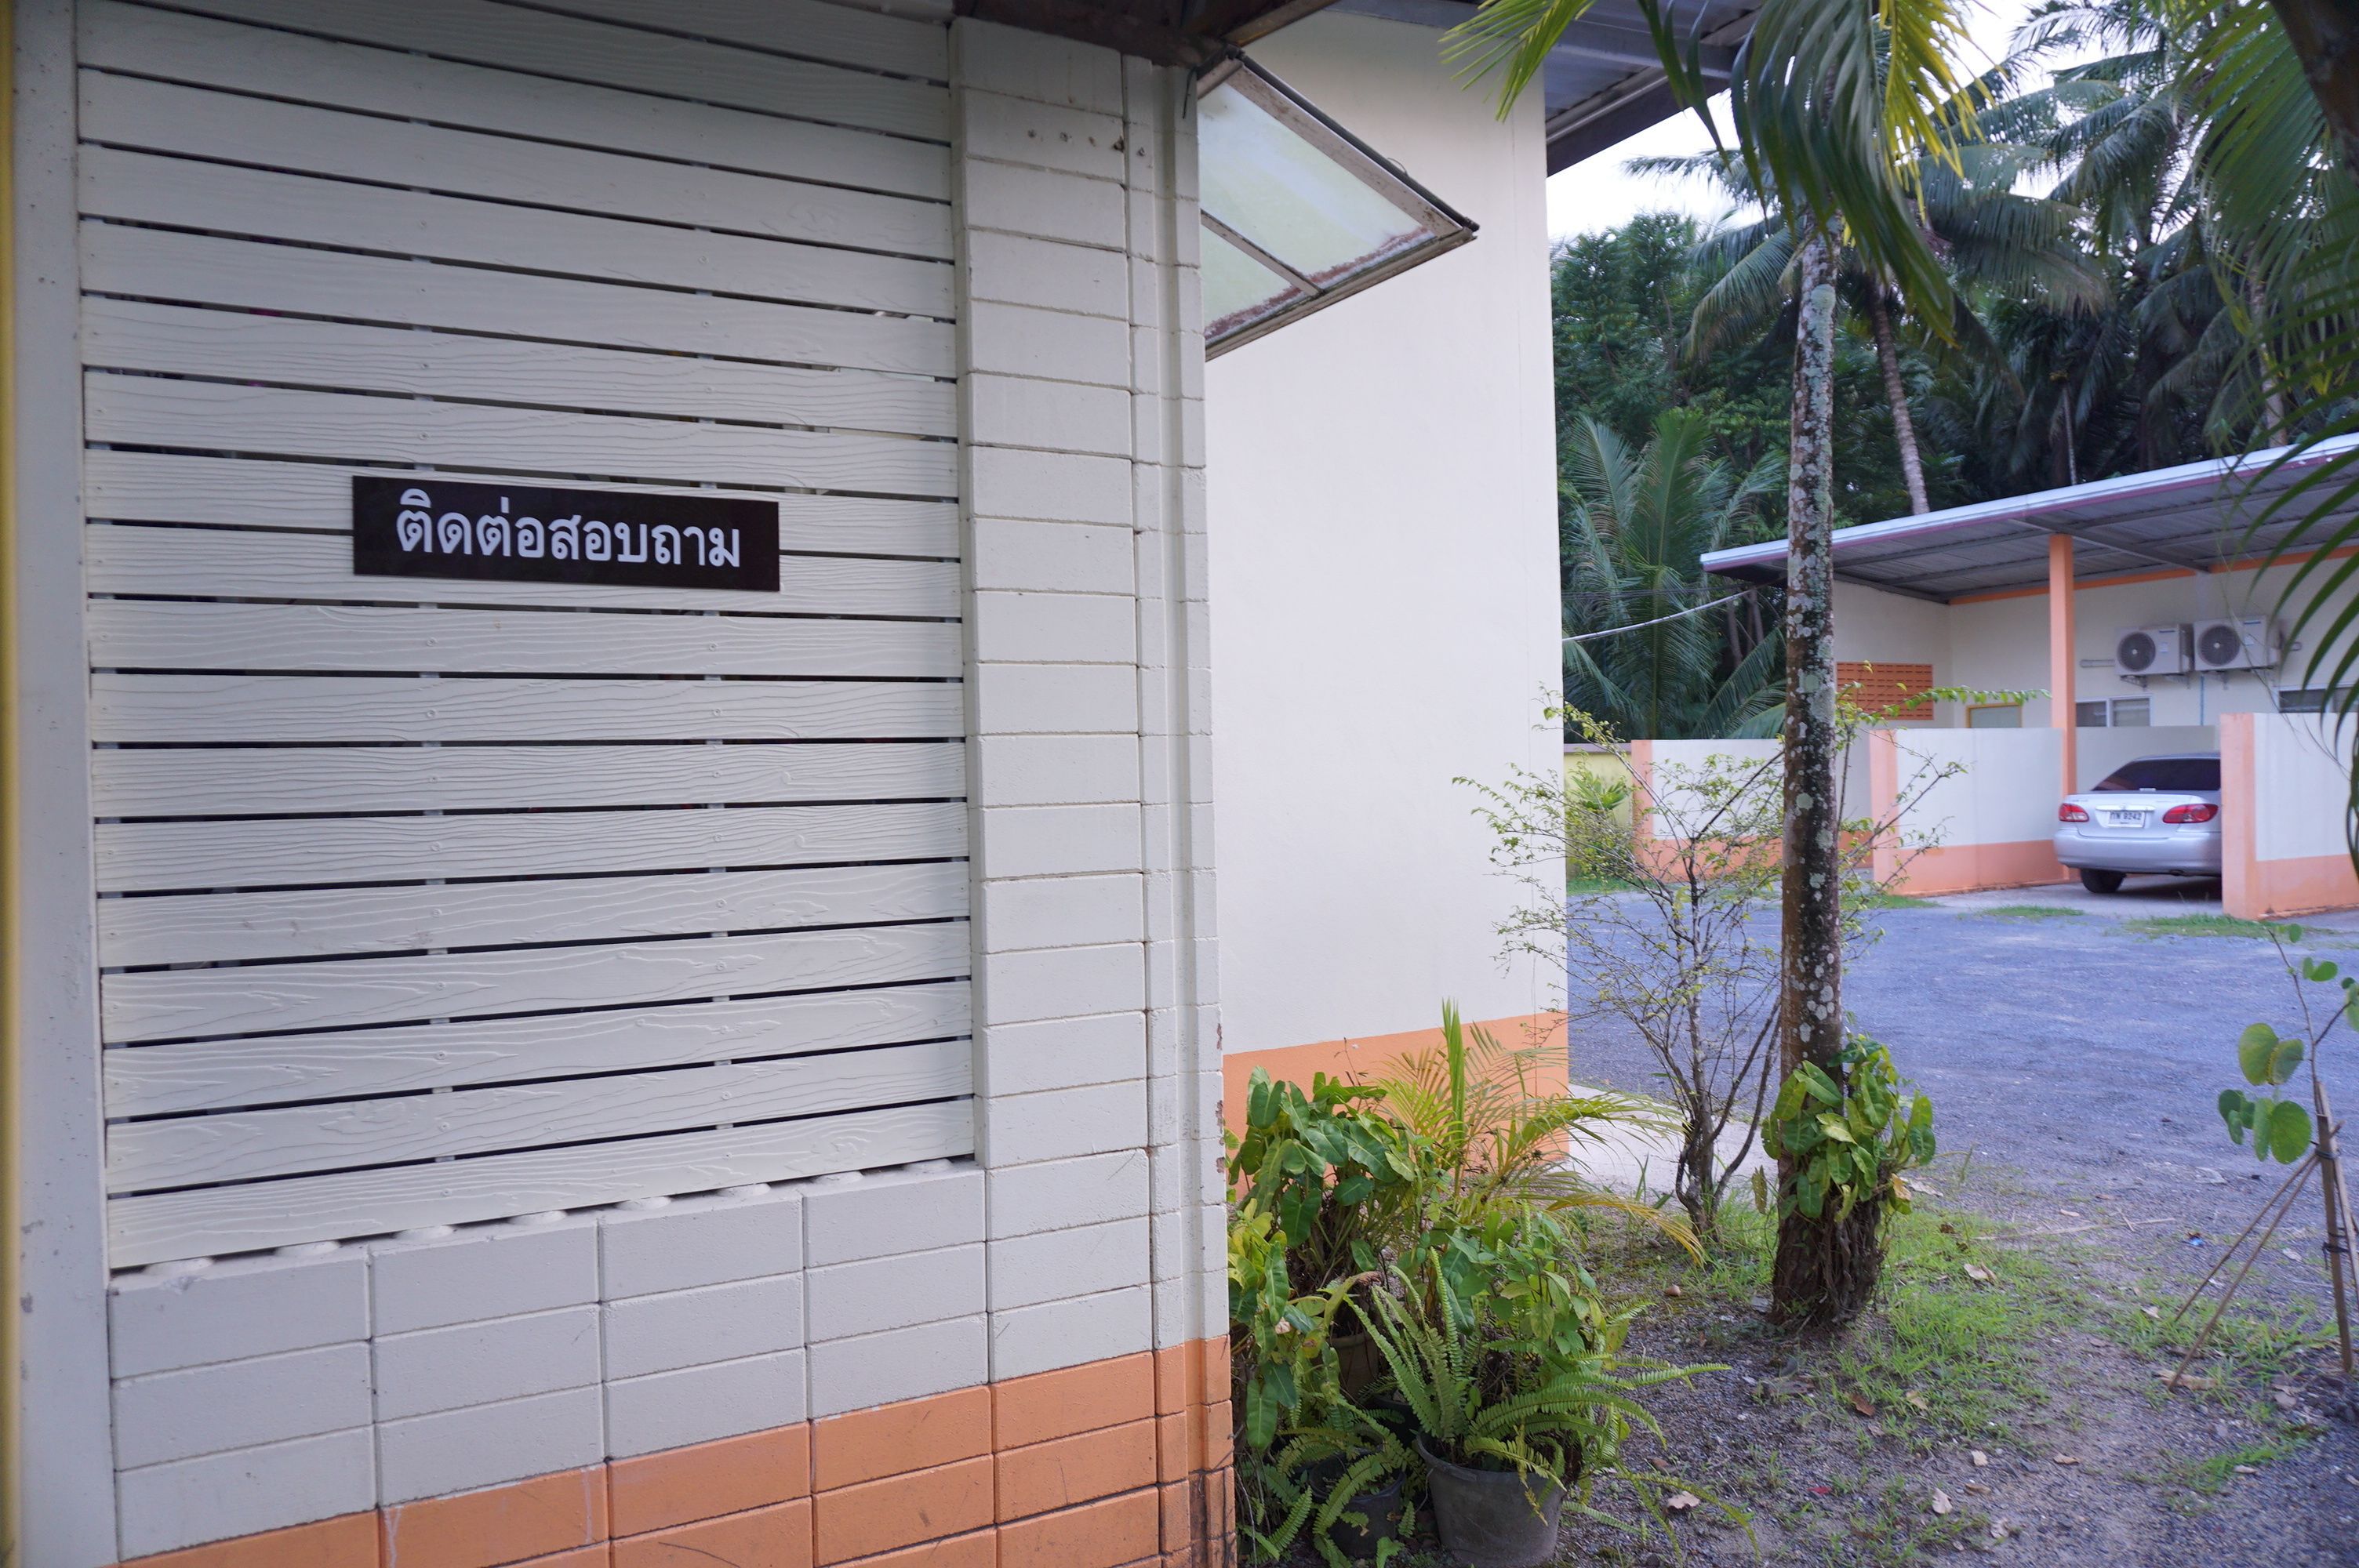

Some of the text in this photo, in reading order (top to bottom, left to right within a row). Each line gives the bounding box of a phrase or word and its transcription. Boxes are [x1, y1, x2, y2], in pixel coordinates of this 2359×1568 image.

[397, 488, 740, 568] ติดต่อสอบถาม
